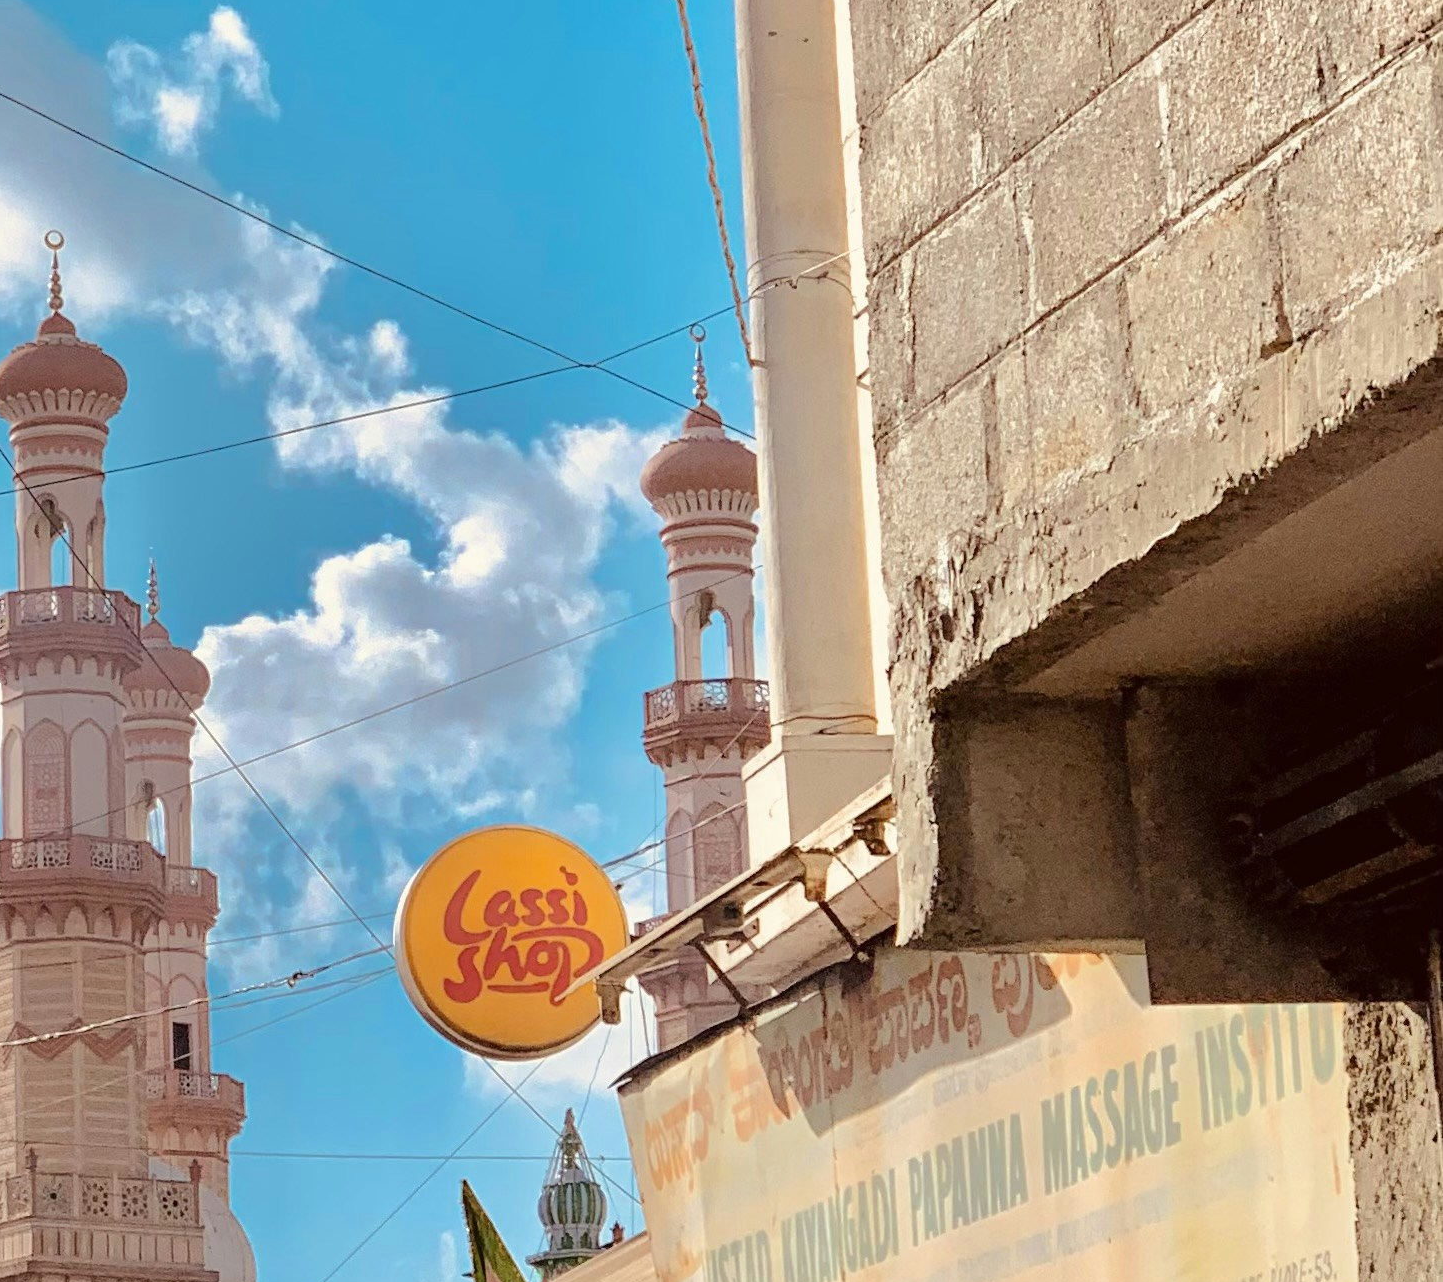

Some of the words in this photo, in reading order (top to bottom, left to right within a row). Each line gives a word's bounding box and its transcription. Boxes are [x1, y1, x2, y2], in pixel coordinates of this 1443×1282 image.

[444, 866, 588, 945] Lassi
[908, 1113, 1029, 1248] PAPANNA
[1040, 1044, 1181, 1196] MASSAGE
[1194, 1004, 1336, 1132] INSTITU
